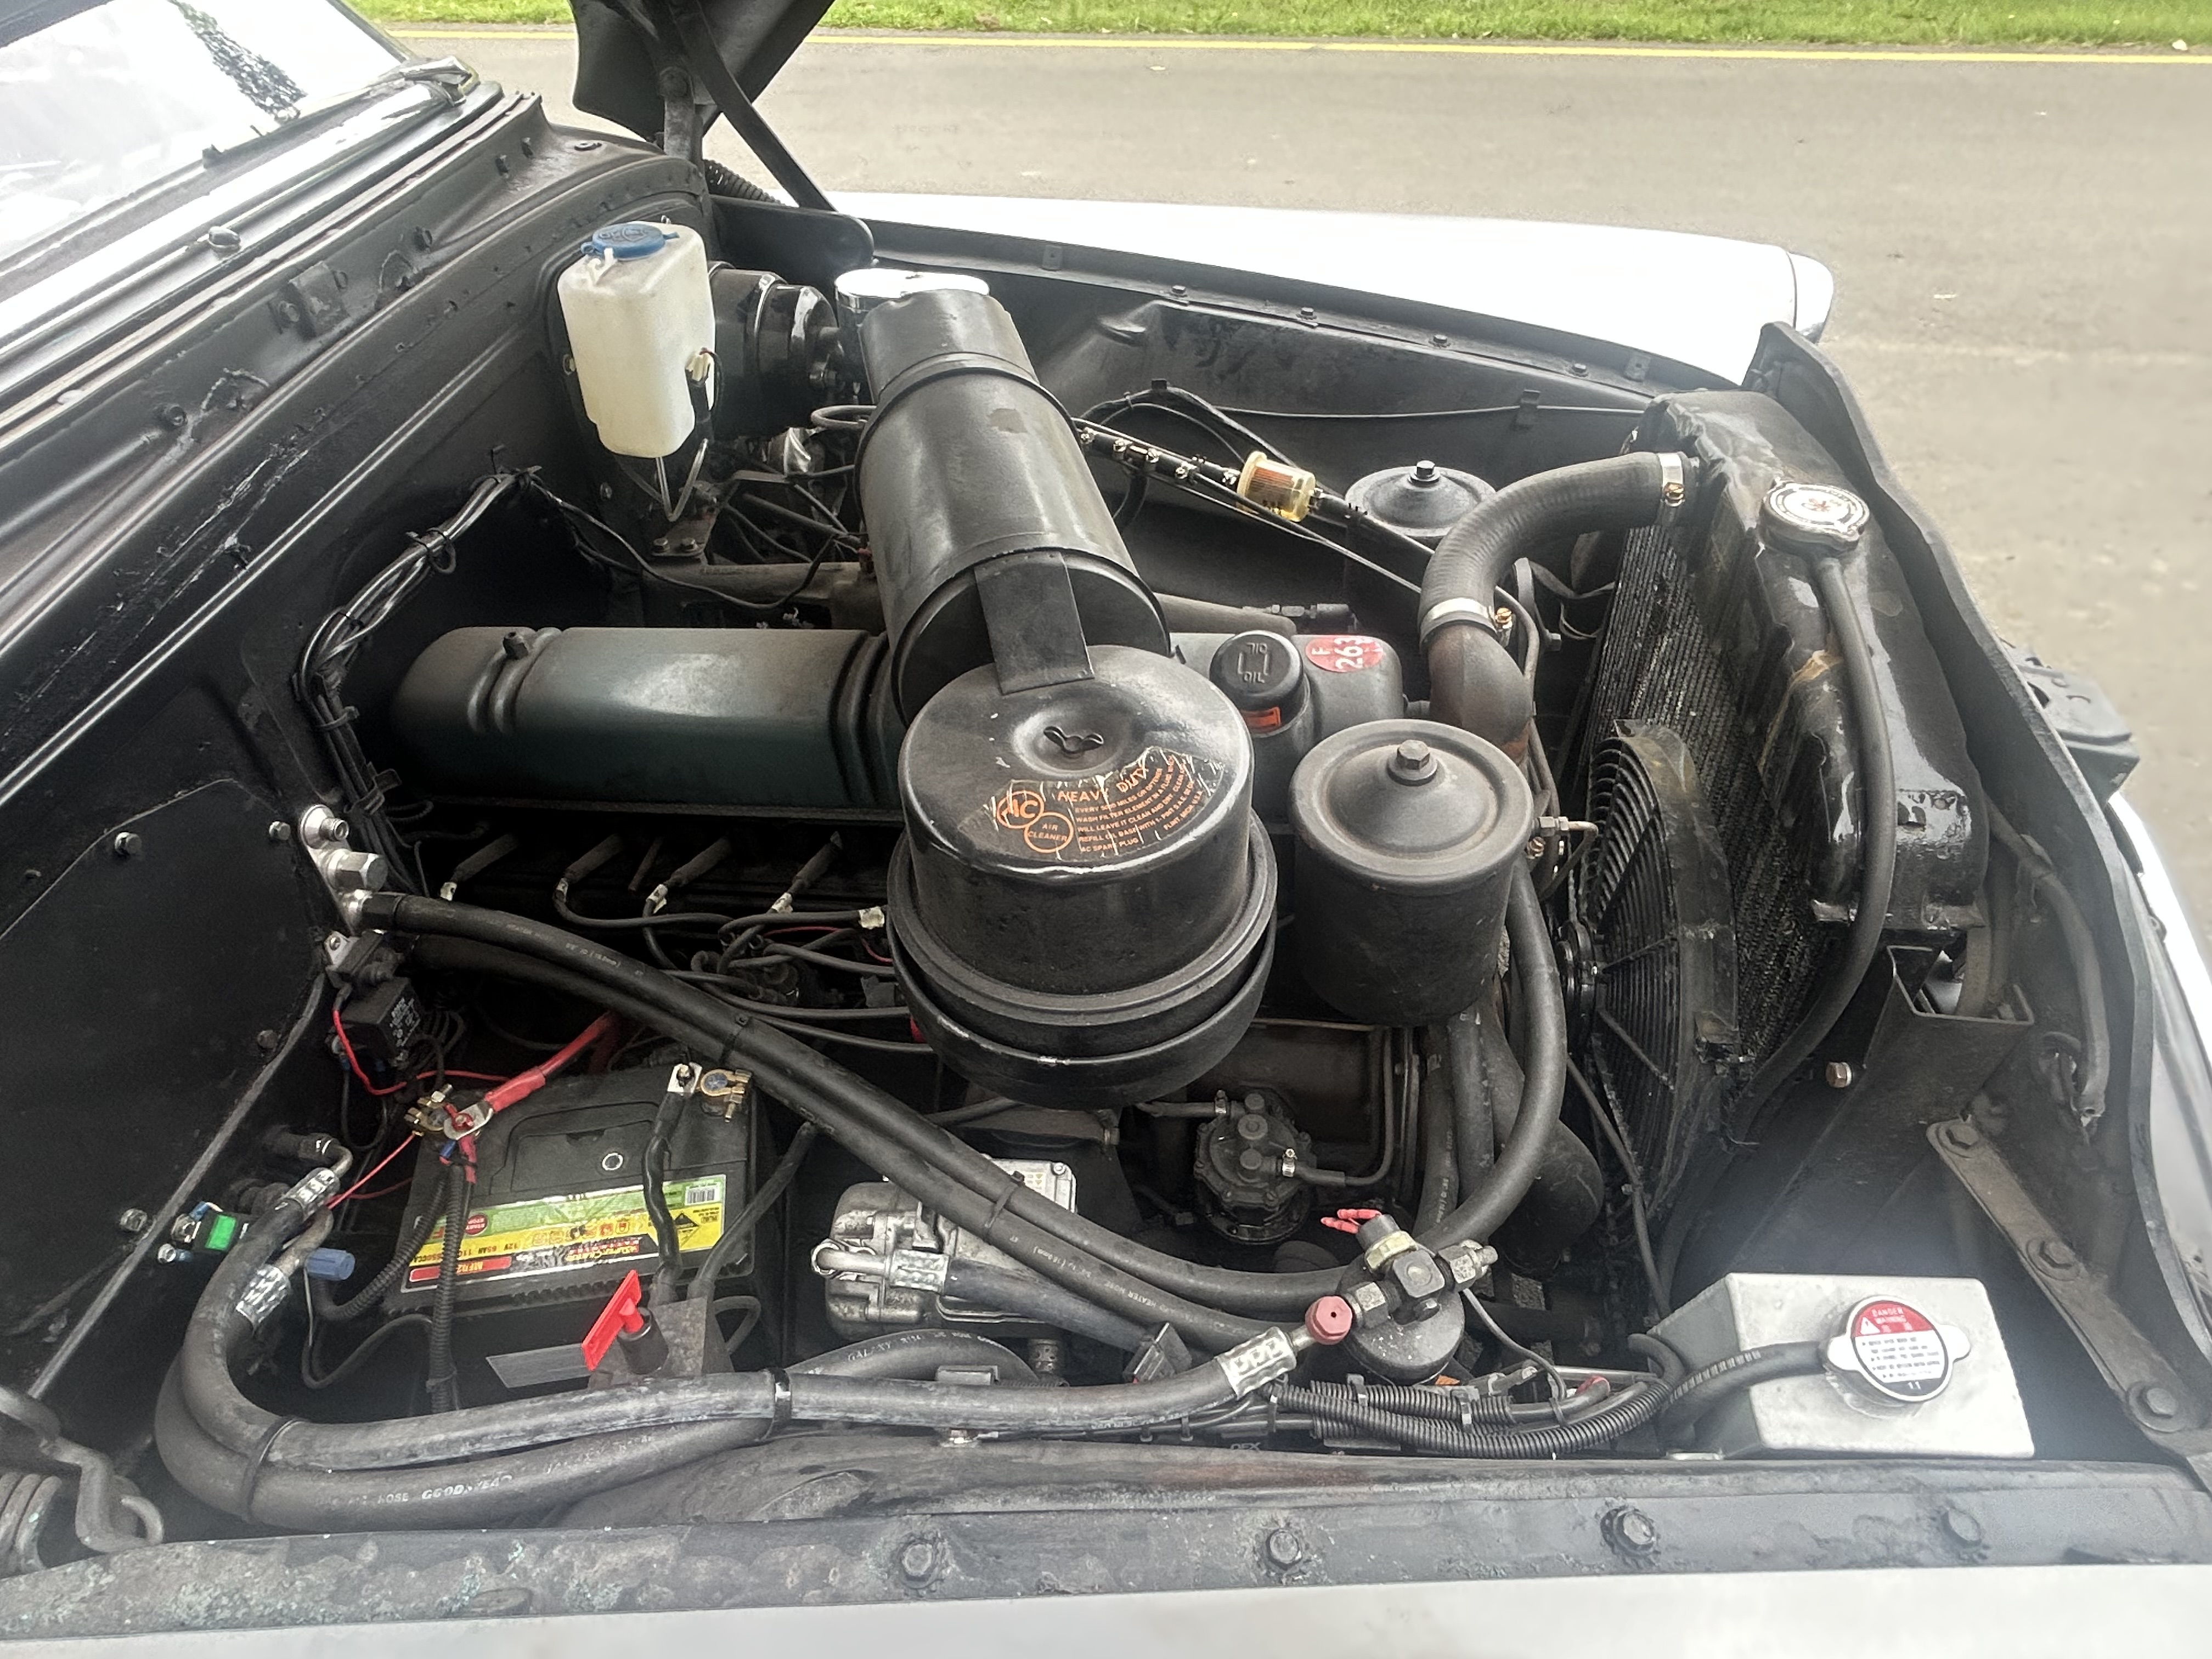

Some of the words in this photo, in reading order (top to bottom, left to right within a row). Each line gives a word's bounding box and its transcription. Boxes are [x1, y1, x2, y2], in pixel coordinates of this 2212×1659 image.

[1246, 642, 1267, 654] OIL
[1311, 647, 1332, 656] F
[1334, 637, 1364, 669] 263
[1243, 672, 1265, 684] OIL
[1116, 794, 1138, 806] MILES
[1124, 797, 1153, 814] ELEMENT
[1096, 821, 1120, 831] LEAVE
[1128, 811, 1152, 823] CLEAN
[1151, 803, 1164, 814] AND
[1042, 823, 1058, 832] AIR
[1028, 831, 1068, 842] CLEANER
[503, 1243, 518, 1251] 12V
[1127, 1291, 1157, 1308] HEATER
[1871, 1307, 1904, 1317] DANGER
